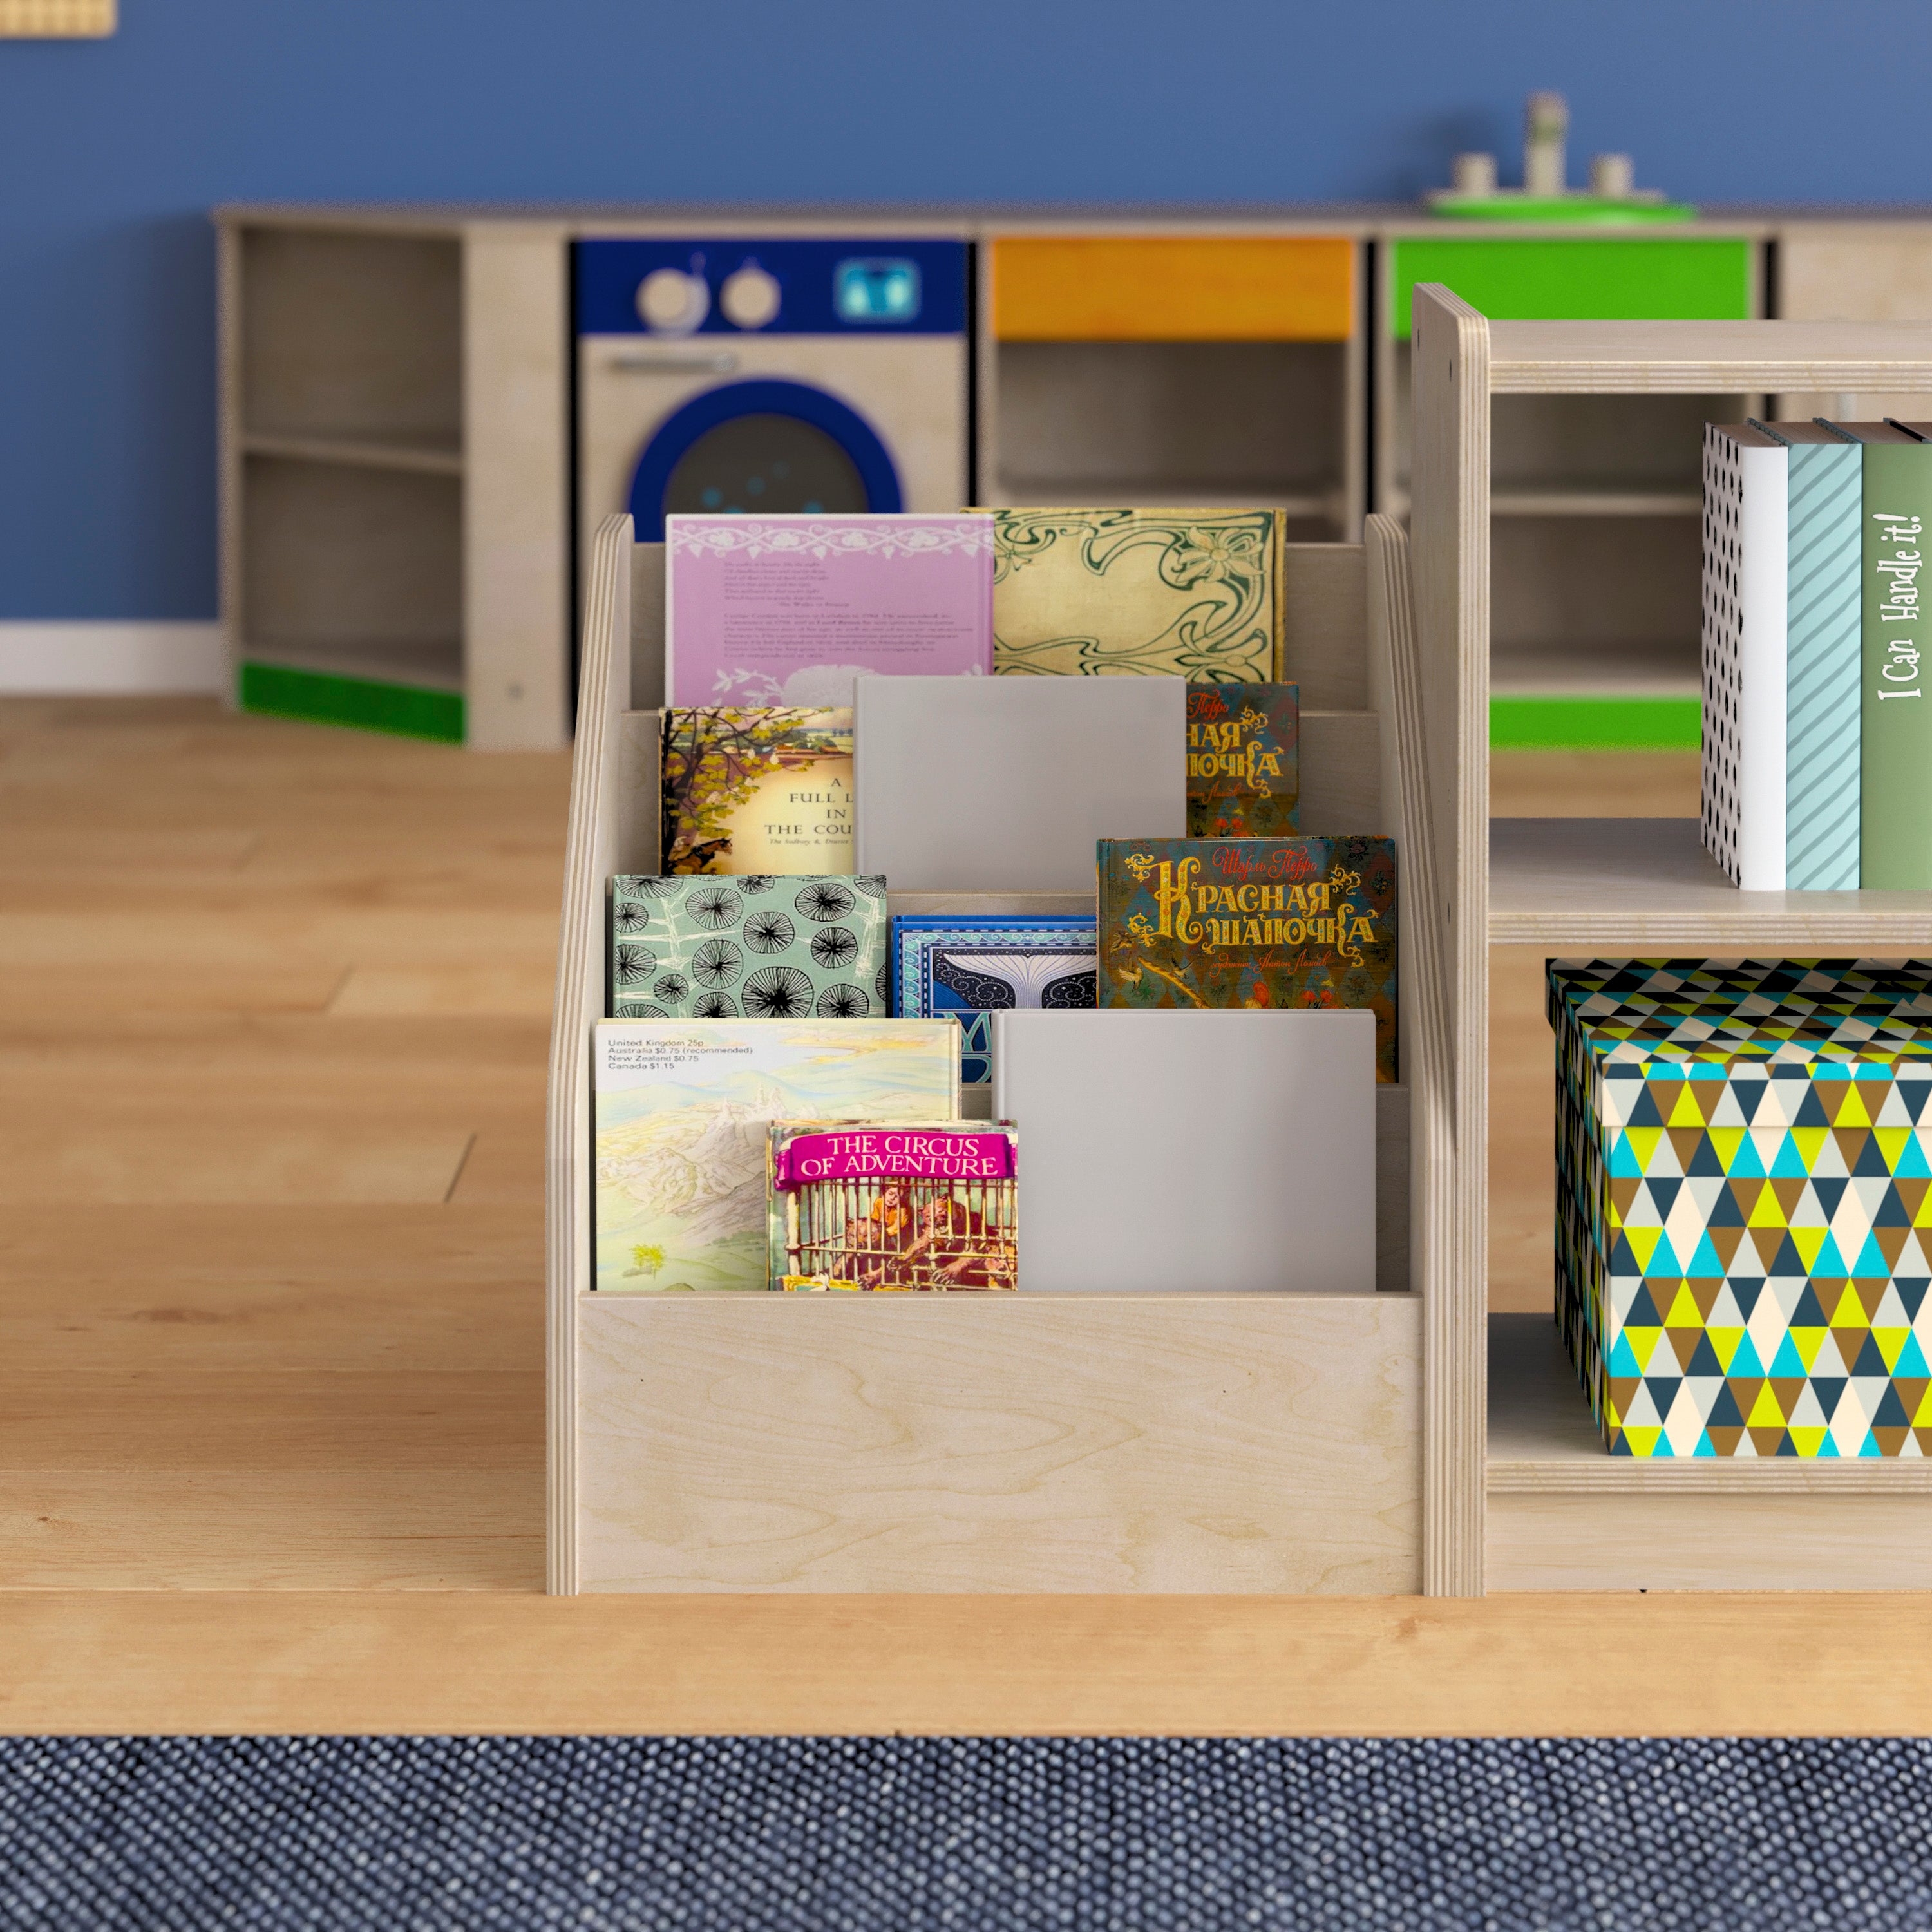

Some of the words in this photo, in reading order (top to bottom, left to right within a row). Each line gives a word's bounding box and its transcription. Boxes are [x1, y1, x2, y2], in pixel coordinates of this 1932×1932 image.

[1872, 513, 1922, 544] it!
[1877, 550, 1922, 621] Handle
[1882, 639, 1920, 682] Can
[1877, 688, 1922, 701] I
[829, 777, 842, 787] A
[790, 793, 836, 803] FULL
[826, 809, 846, 819] IN
[764, 824, 803, 834] THE
[814, 824, 852, 835] COU
[1213, 846, 1266, 882] Шарль
[1268, 846, 1318, 881] Перро
[1202, 904, 1379, 966] ШАПОЧКА
[646, 1039, 685, 1048] Kingdom
[687, 1039, 704, 1048] 25p
[827, 1135, 877, 1155] THE
[885, 1135, 979, 1157] CIRCUS
[800, 1157, 835, 1176] OF
[844, 1155, 998, 1176] ADVENTURE
